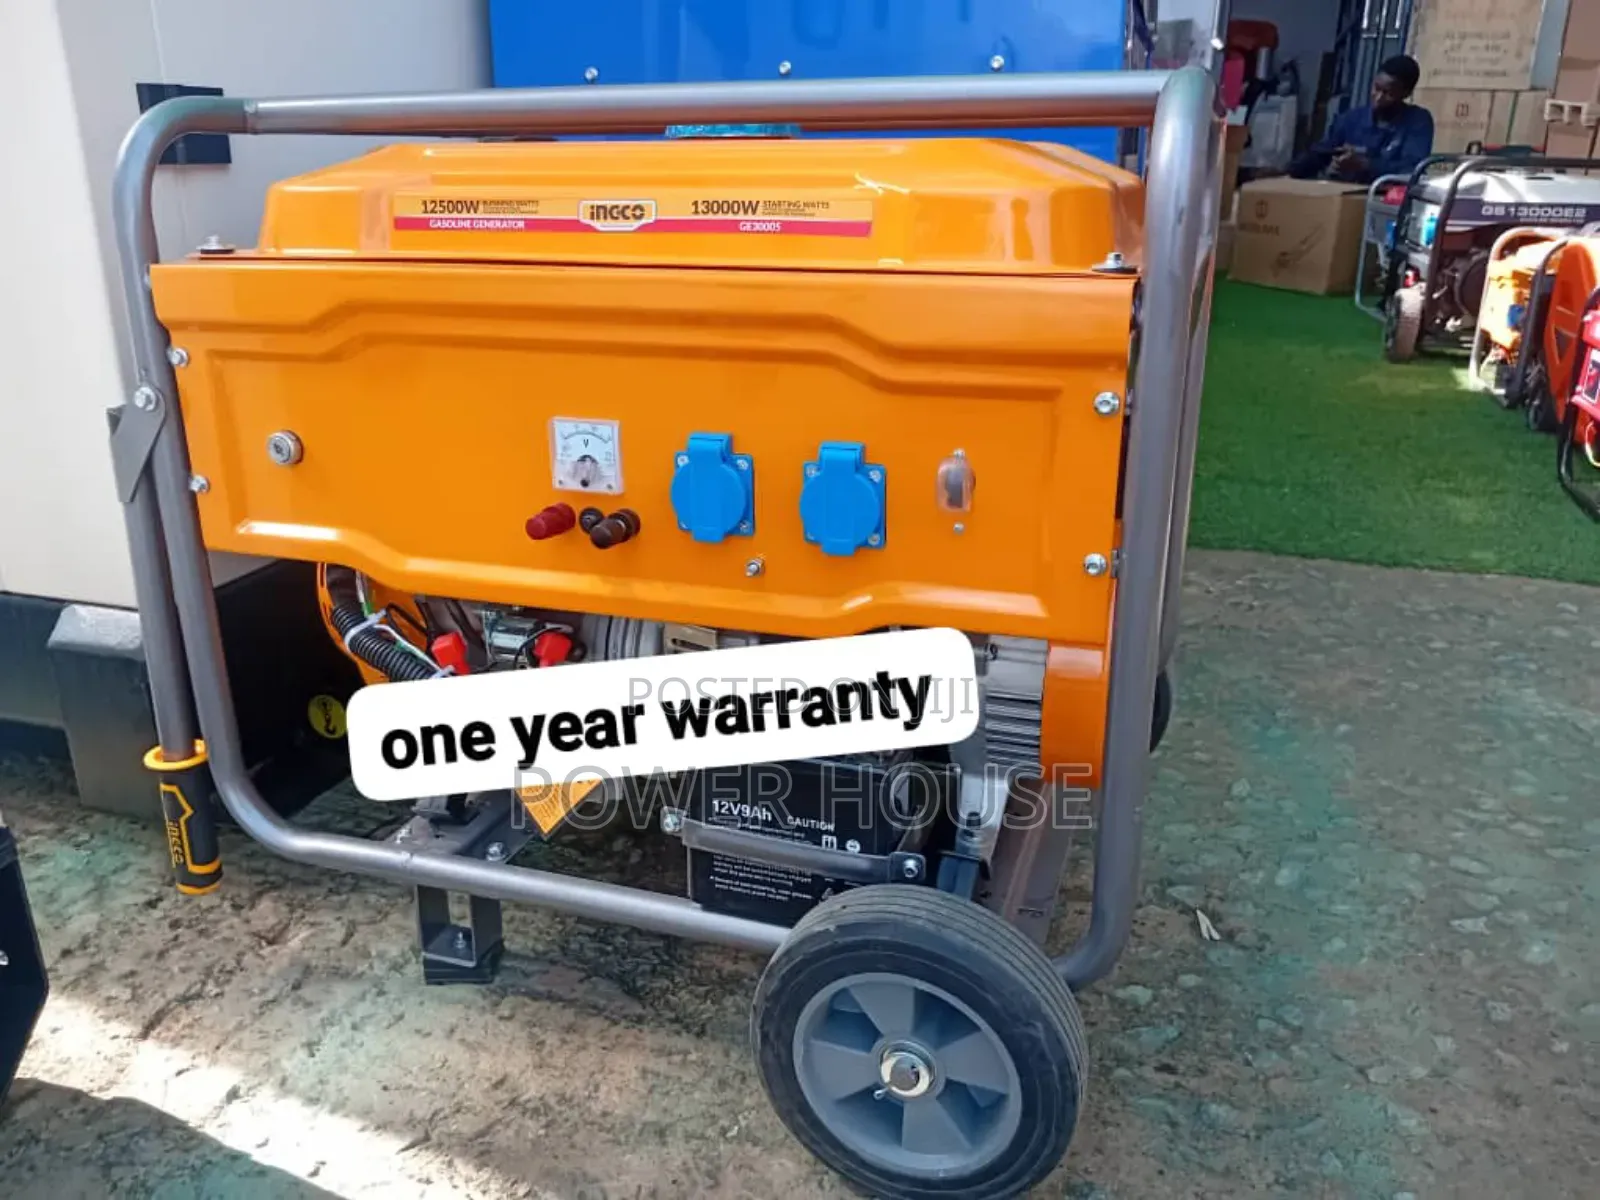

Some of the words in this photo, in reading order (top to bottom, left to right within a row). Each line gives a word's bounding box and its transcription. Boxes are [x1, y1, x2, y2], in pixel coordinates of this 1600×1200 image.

[421, 199, 479, 215] 12500W
[691, 200, 760, 216] 13000W
[429, 217, 471, 229] GASOLINE
[474, 218, 525, 229] GENERATOR
[711, 799, 773, 822] 12V9Ah
[786, 815, 836, 832] CAUTION
